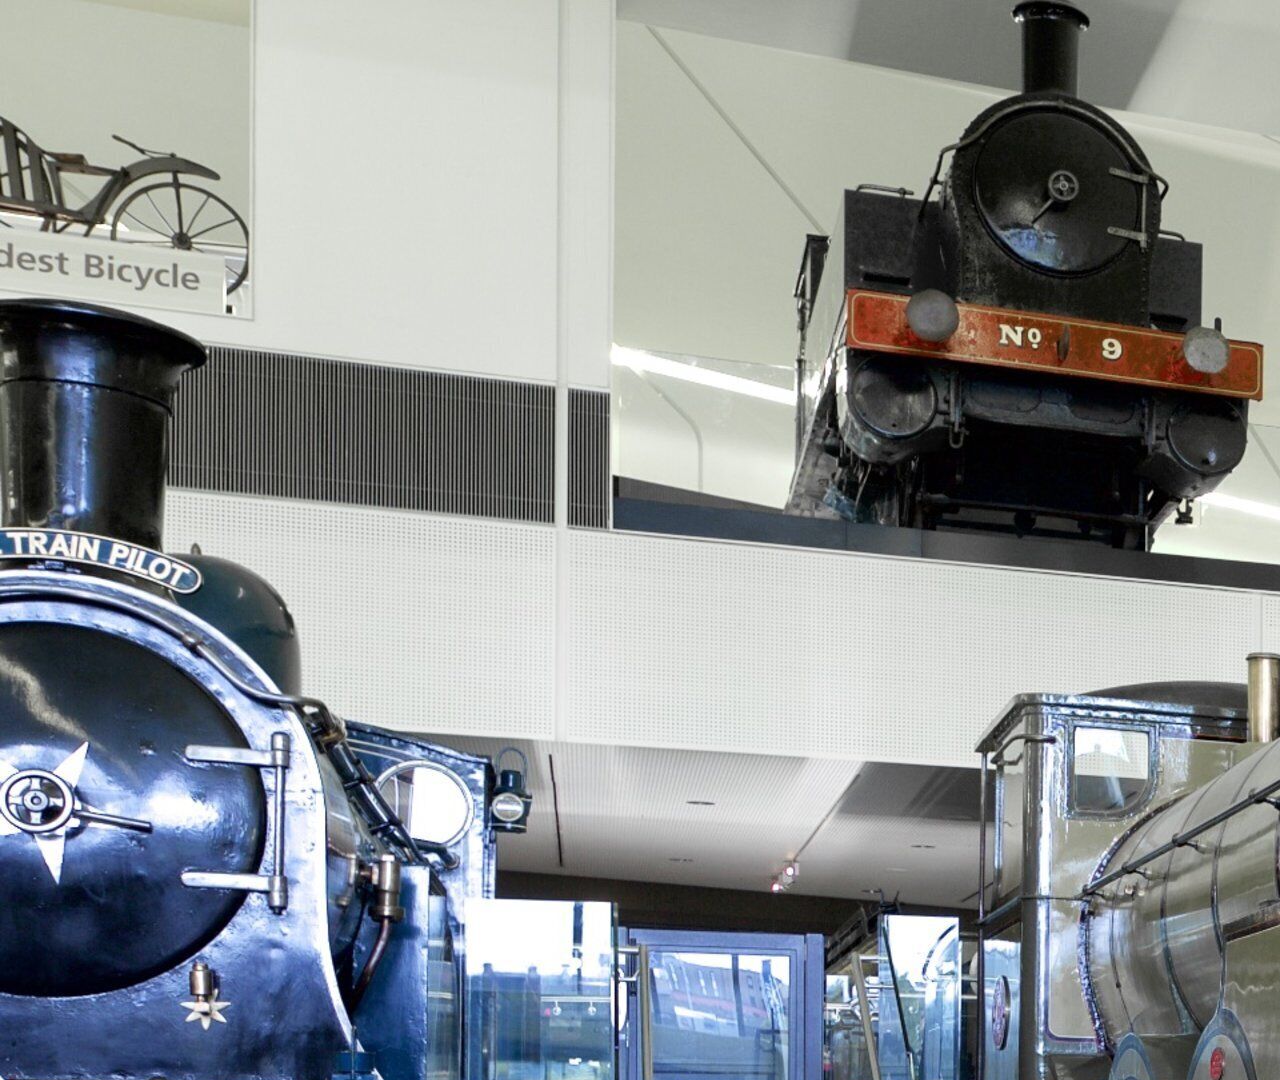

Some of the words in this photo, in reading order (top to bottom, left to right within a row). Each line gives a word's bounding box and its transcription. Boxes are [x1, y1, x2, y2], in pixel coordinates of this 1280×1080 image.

[84, 253, 201, 292] Bicycle
[1101, 338, 1123, 360] 9
[6, 531, 101, 562] TRAIN
[108, 542, 191, 587] PILOT
